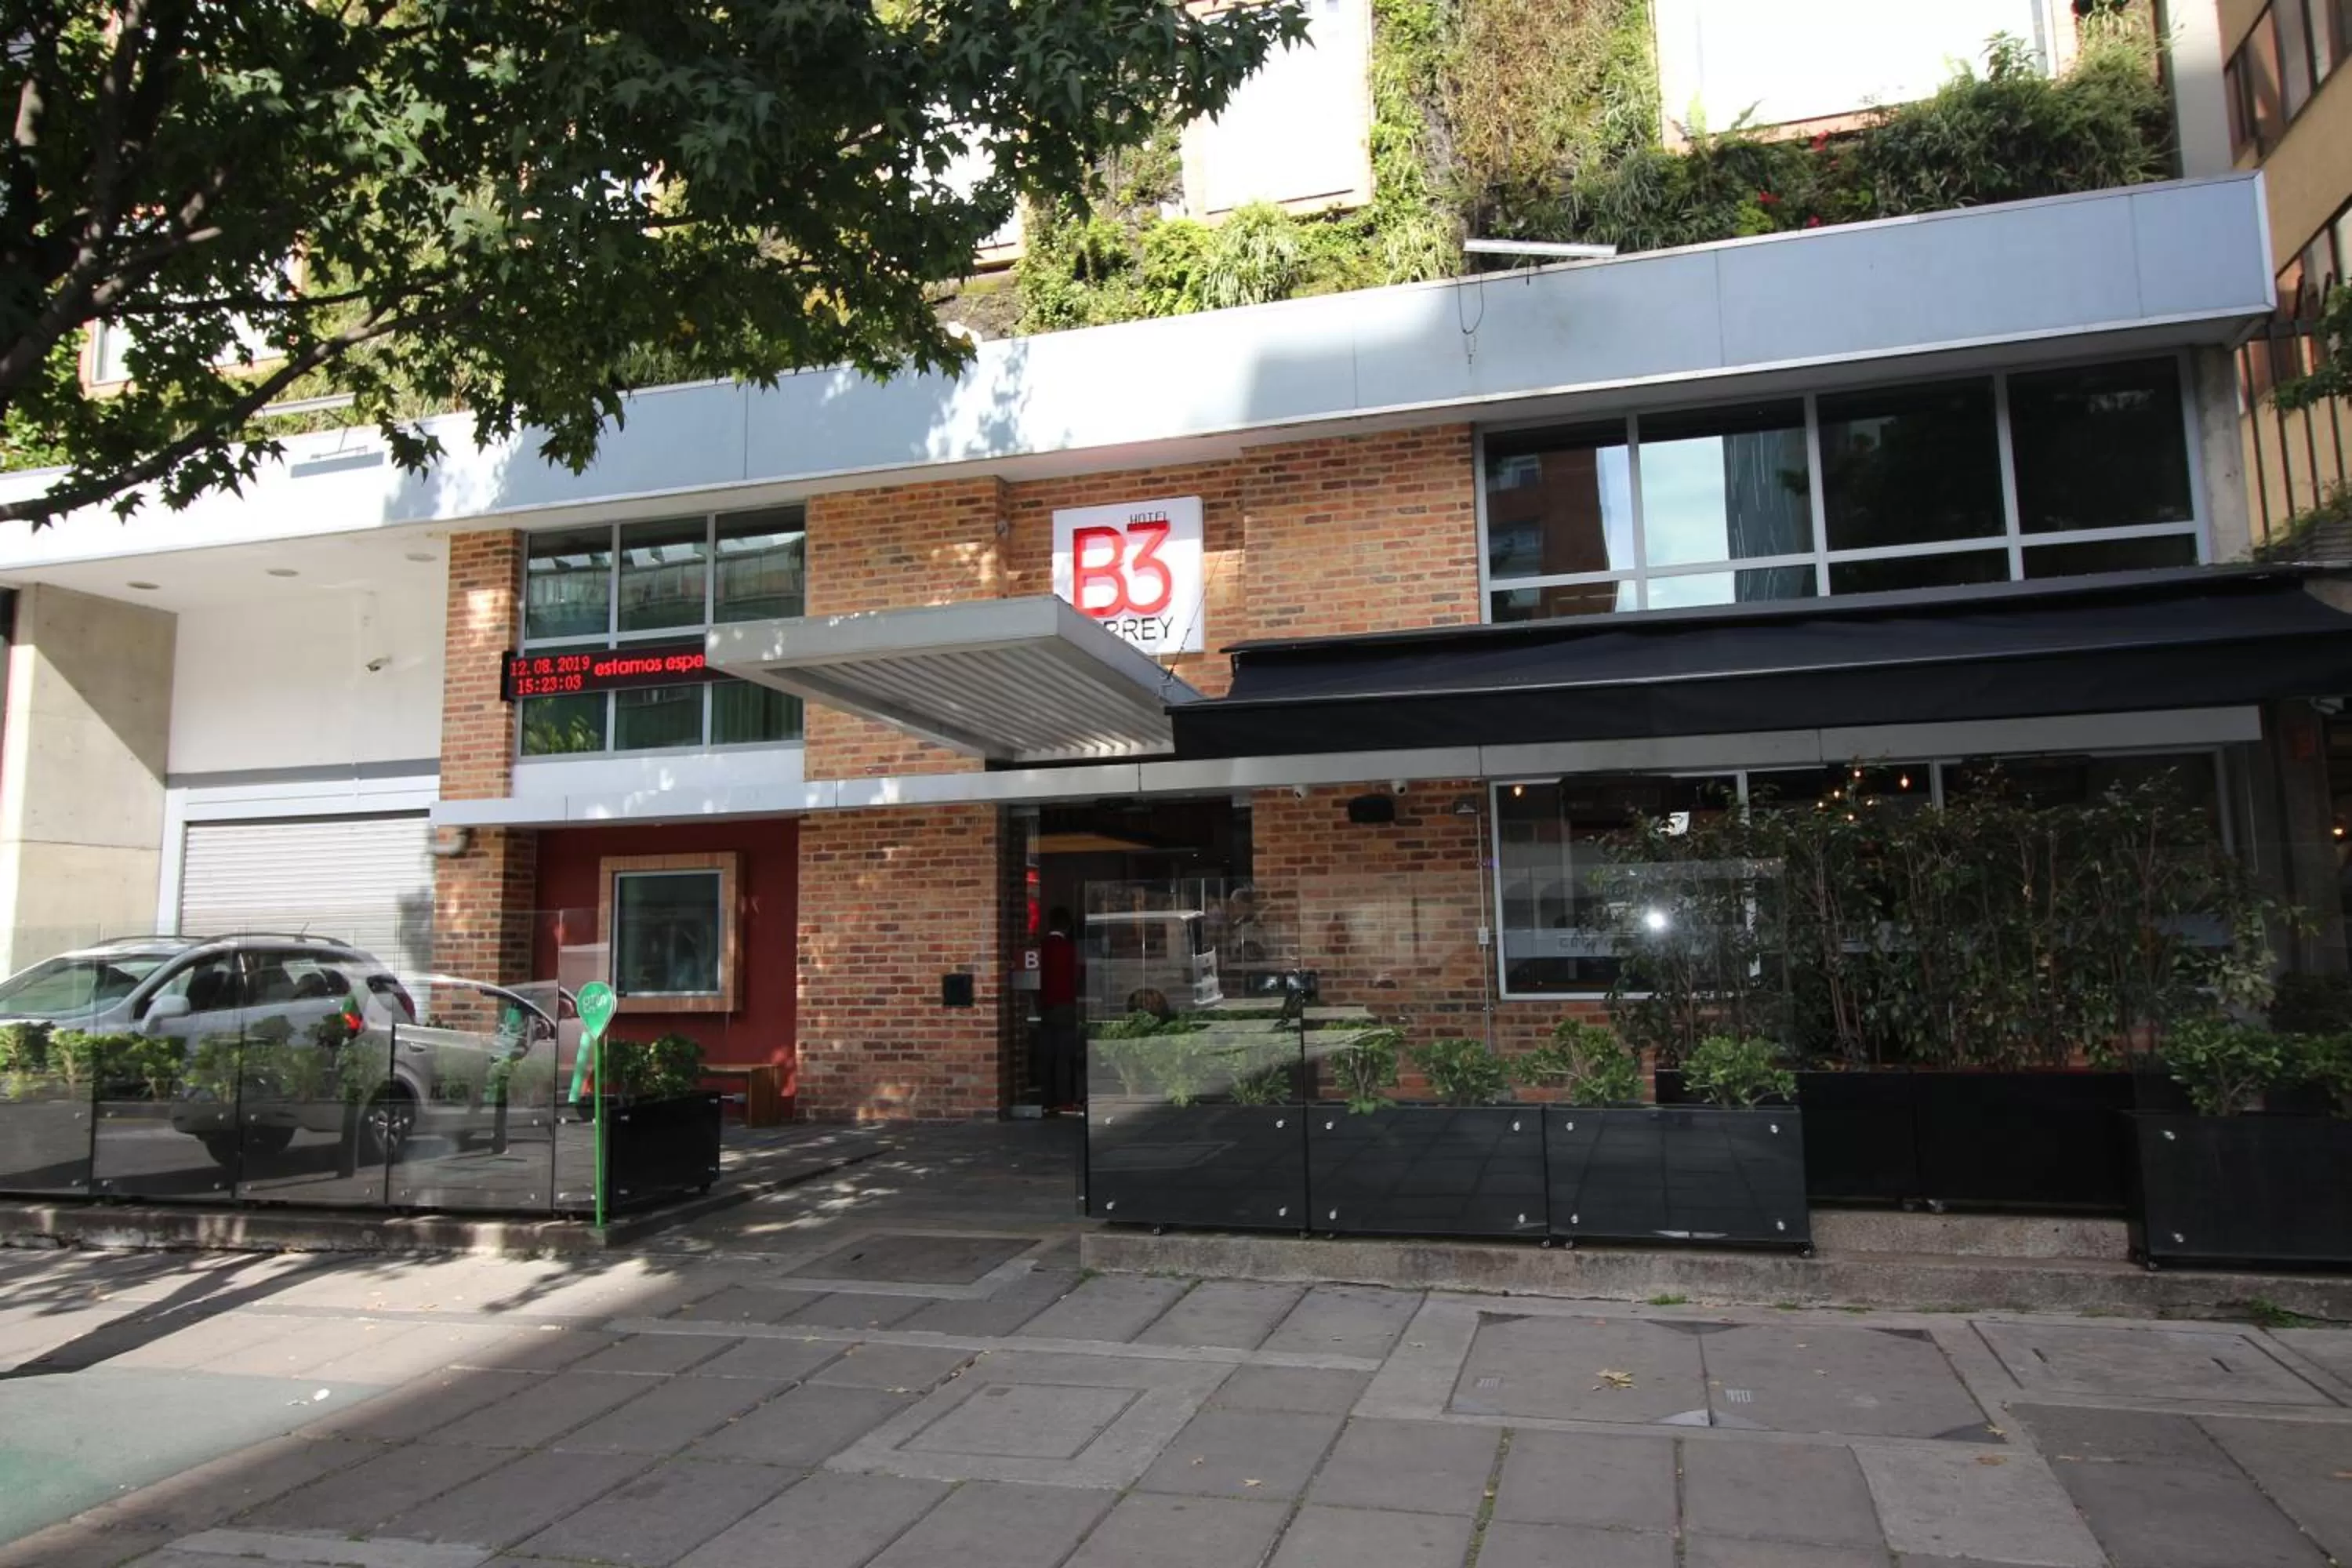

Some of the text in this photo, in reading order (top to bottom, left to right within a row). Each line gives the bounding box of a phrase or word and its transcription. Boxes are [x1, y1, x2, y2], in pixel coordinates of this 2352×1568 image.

[1073, 521, 1172, 618] B3
[594, 655, 704, 677] estamos espe
[517, 674, 582, 695] 15:23:03
